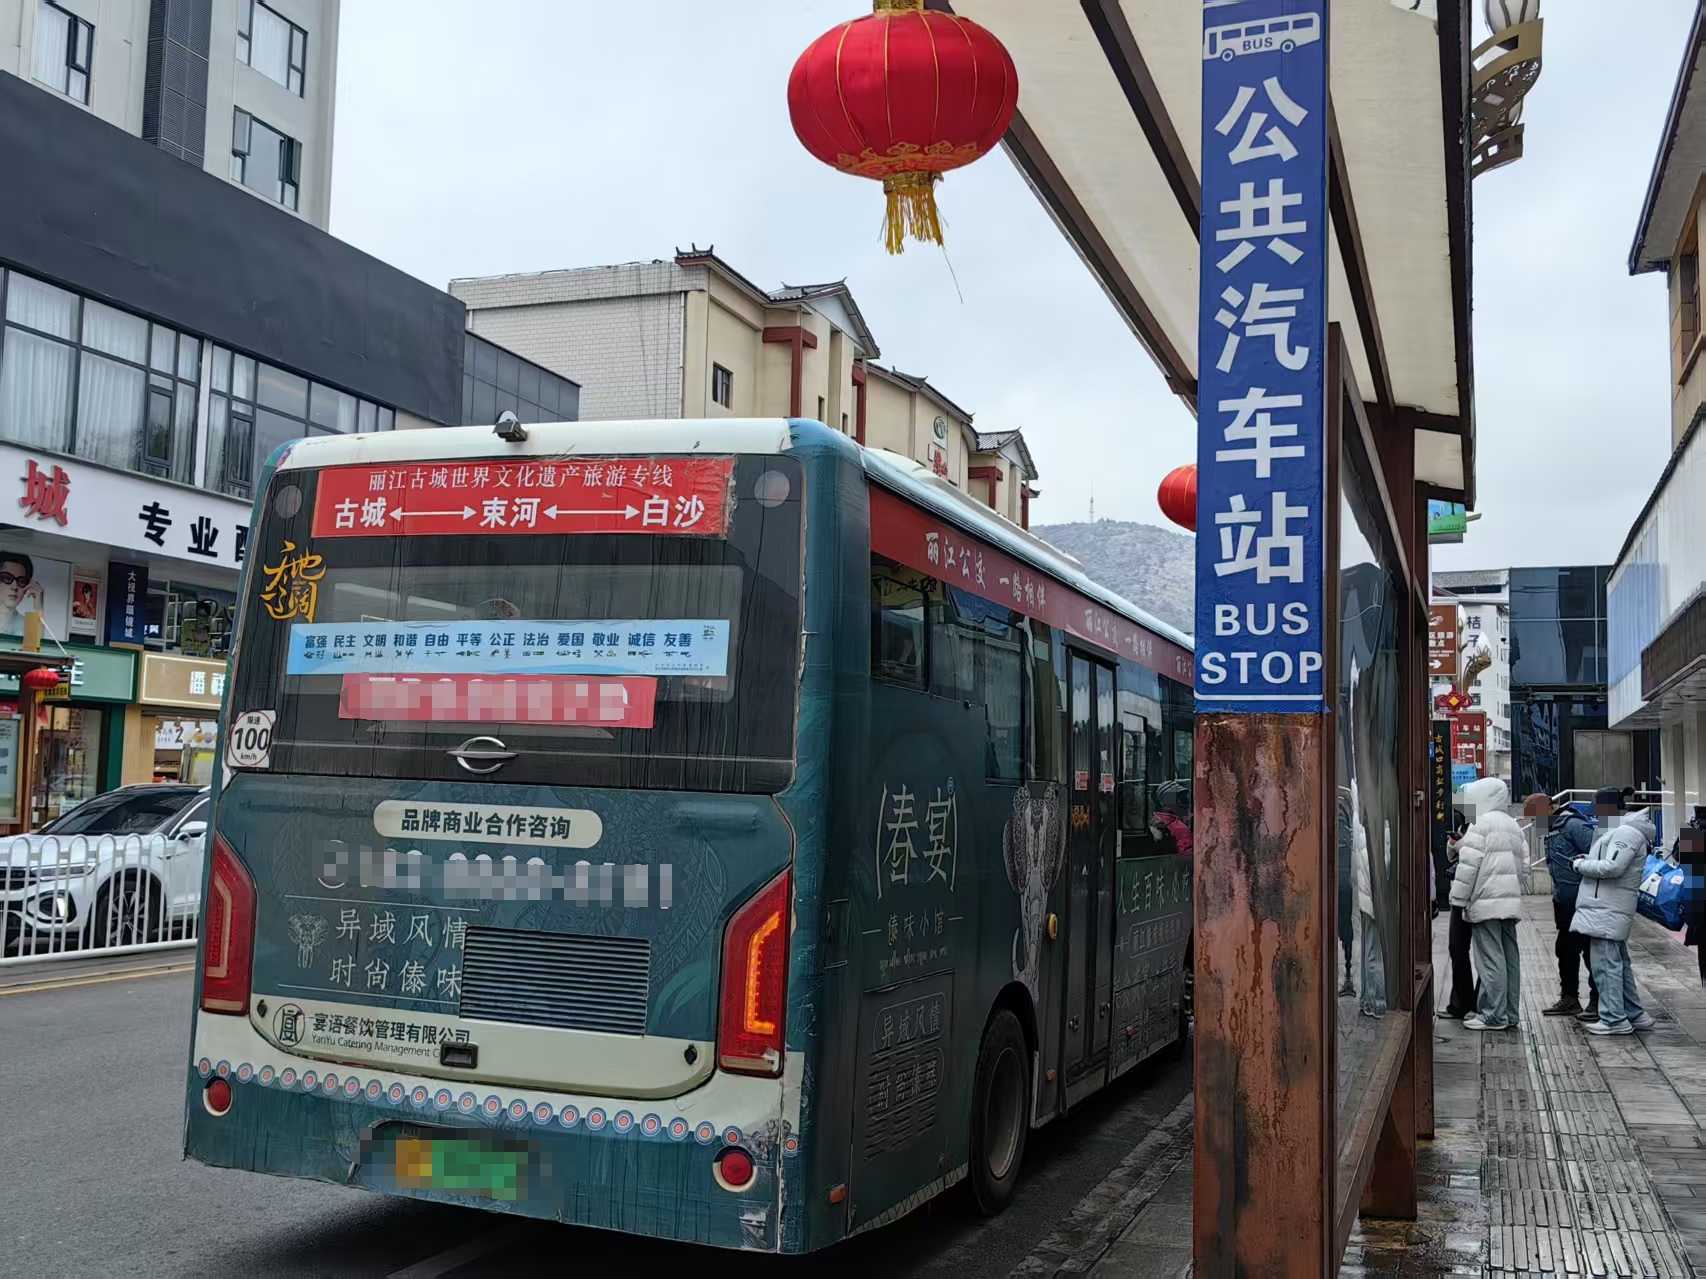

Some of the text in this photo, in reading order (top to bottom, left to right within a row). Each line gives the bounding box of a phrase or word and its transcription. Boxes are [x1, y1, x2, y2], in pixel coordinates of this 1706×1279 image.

[1242, 37, 1273, 51] BUS
[1214, 76, 1309, 585] 公共汽车站
[19, 459, 70, 526] 城
[369, 464, 673, 491] 丽江古城世界文化遗产旅游专线
[334, 494, 705, 529] 古城 束河 白沙
[925, 532, 986, 590] 丽江公交
[1214, 602, 1309, 637] BUS
[305, 635, 327, 648] 富强
[334, 634, 356, 648] 民主
[363, 634, 387, 647] 文明
[394, 633, 418, 647] 和谐
[424, 633, 449, 647] 自由
[456, 633, 482, 646] 平等
[489, 633, 515, 646] 公正
[523, 633, 549, 646] 法治
[557, 632, 584, 646] 爱国
[592, 632, 619, 646] 敬业
[628, 632, 656, 646] 诚信
[664, 632, 693, 647] 友善
[1200, 651, 1323, 685] STOP
[235, 728, 269, 750] 100
[401, 808, 571, 839] 品牌商业合作咨询
[336, 907, 468, 950] 异域风情
[329, 954, 462, 998] 时尚傣味
[313, 1012, 471, 1046] 宴语餐饮管理有限公司
[337, 1038, 373, 1052] Catering
[374, 1041, 431, 1057] Management
